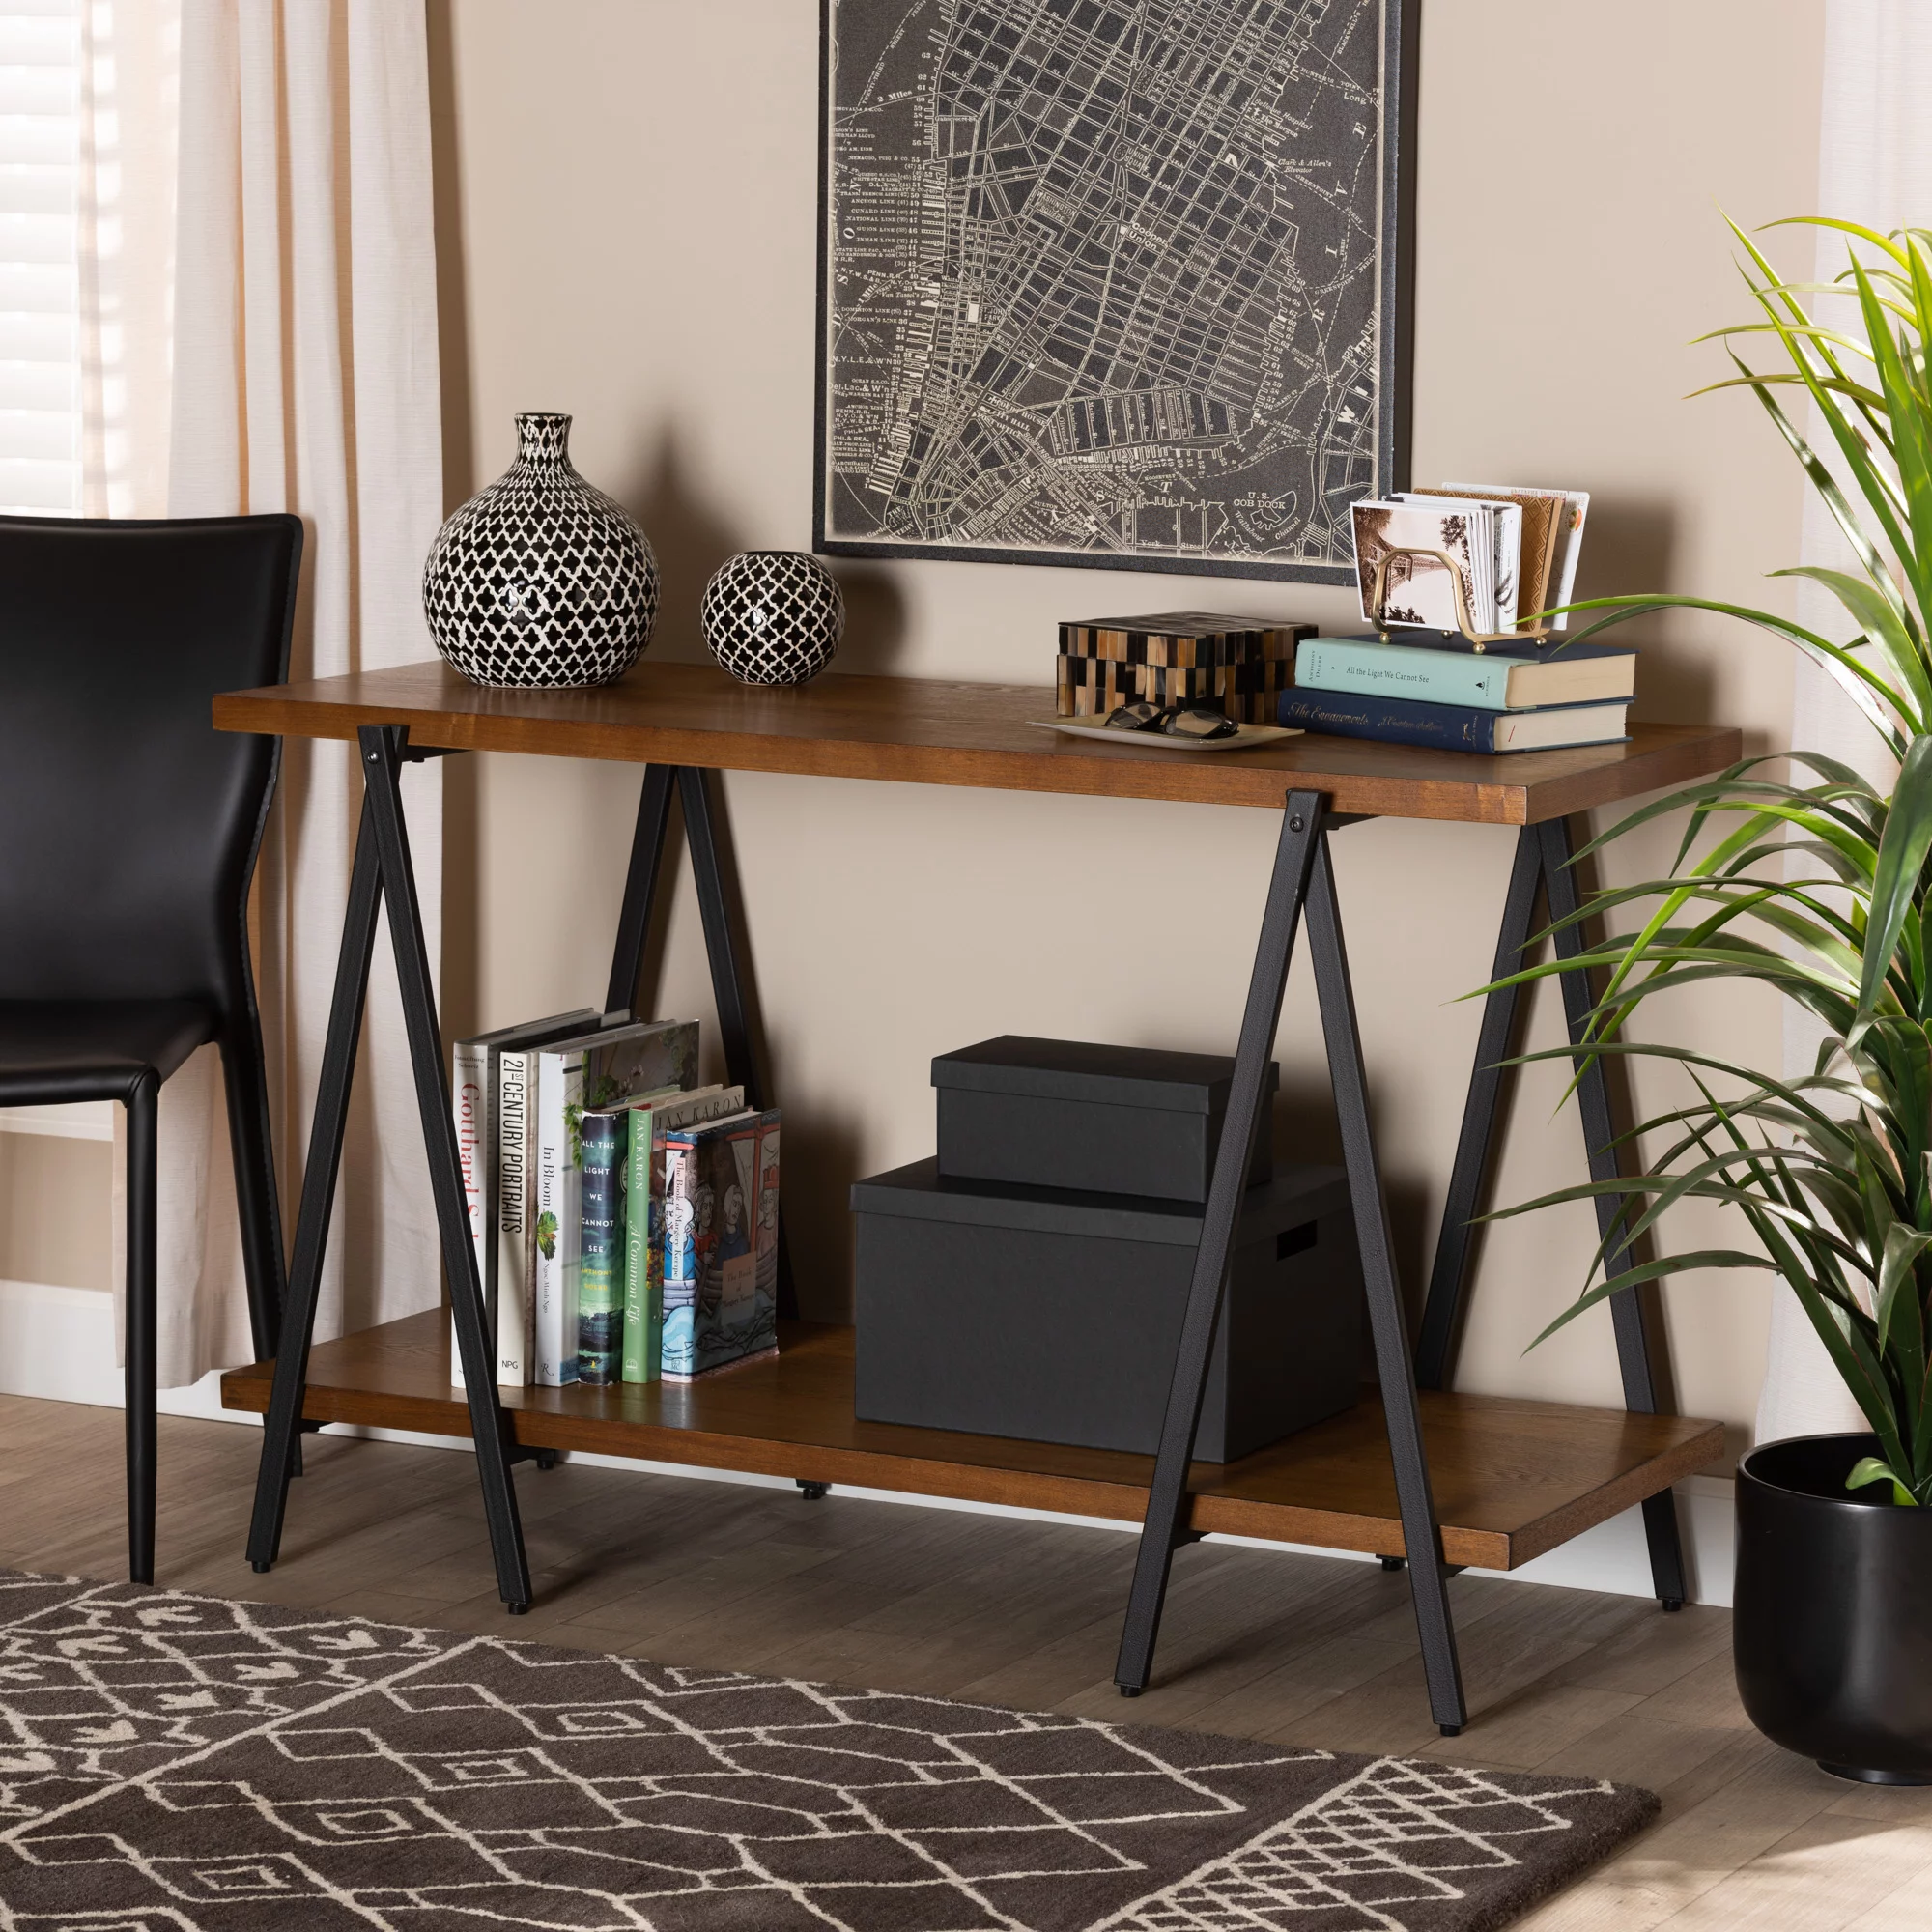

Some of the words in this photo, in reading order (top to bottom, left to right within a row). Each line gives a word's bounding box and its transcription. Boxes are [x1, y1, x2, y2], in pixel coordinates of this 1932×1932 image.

[888, 90, 913, 100] Miles
[1344, 92, 1367, 105] Long
[1129, 231, 1157, 250] Union
[1132, 222, 1168, 248] Cooper
[1258, 500, 1286, 510] DOCK
[1275, 517, 1300, 540] Channel
[1367, 668, 1383, 679] Light
[1395, 671, 1418, 681] Cannot
[1419, 674, 1430, 683] See
[1288, 702, 1310, 717] The
[502, 1082, 524, 1151] CENTURY
[657, 1110, 684, 1131] JAN
[693, 1094, 741, 1121] KARON
[461, 1083, 480, 1193] Gotthard
[637, 1118, 645, 1140] JAN
[543, 1147, 554, 1159] In
[584, 1166, 610, 1175] LIGHT
[636, 1146, 644, 1189] KARON
[501, 1153, 523, 1234] PORTRAITS
[543, 1164, 554, 1206] Bloom
[582, 1217, 614, 1227] CANNOT
[629, 1220, 641, 1237] A
[673, 1214, 682, 1246] Margery
[629, 1240, 641, 1298] Common
[672, 1250, 682, 1277] Kempe
[626, 1302, 640, 1325] Life
[502, 1360, 518, 1369] NPG
